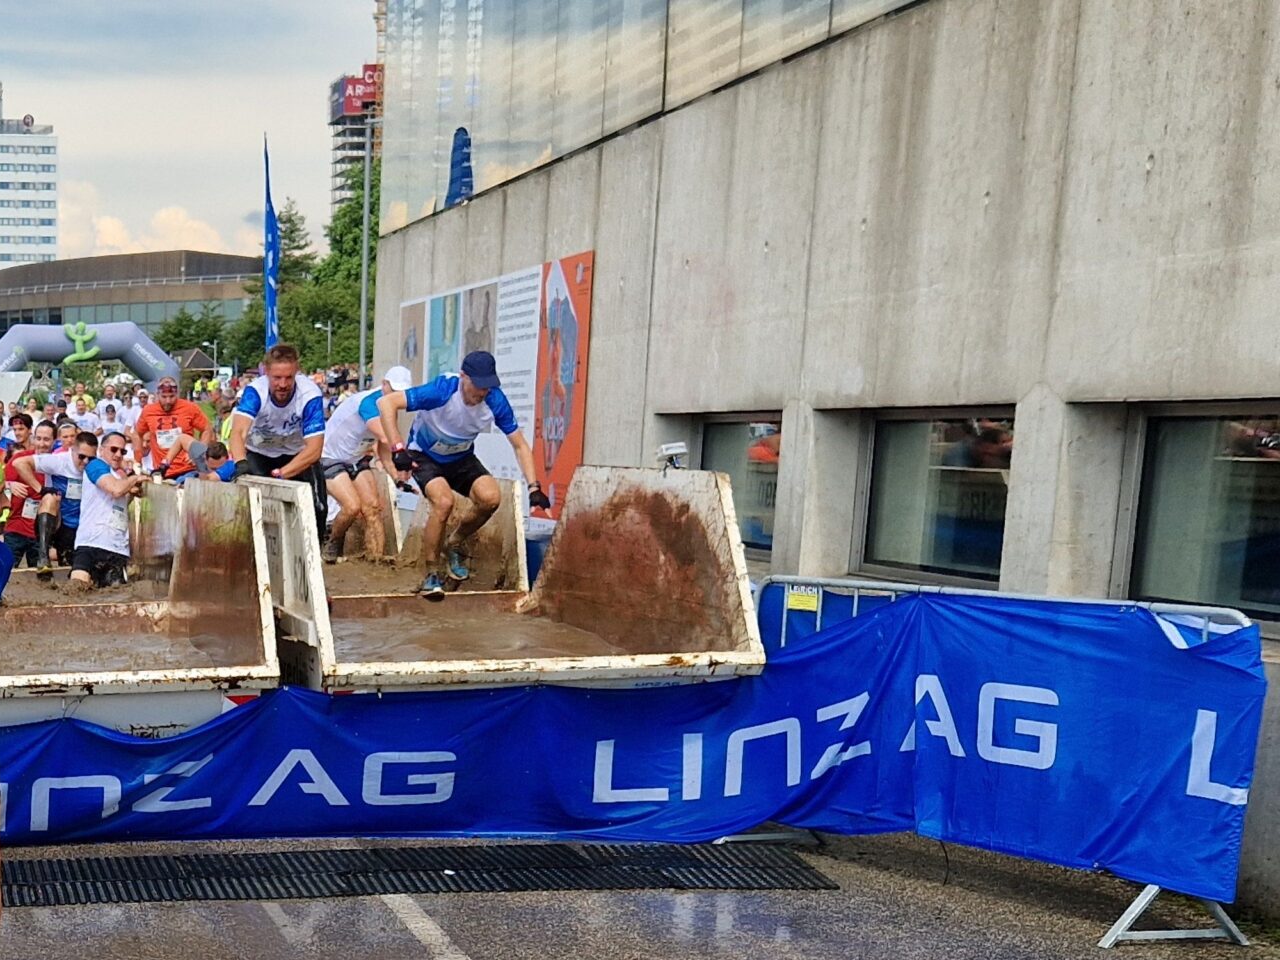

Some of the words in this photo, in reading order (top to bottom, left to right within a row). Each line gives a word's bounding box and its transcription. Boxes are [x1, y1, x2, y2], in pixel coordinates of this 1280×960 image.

[133, 342, 159, 365] merkur
[592, 691, 872, 803] LINZ
[899, 673, 1060, 770] AG
[248, 749, 456, 807] AG
